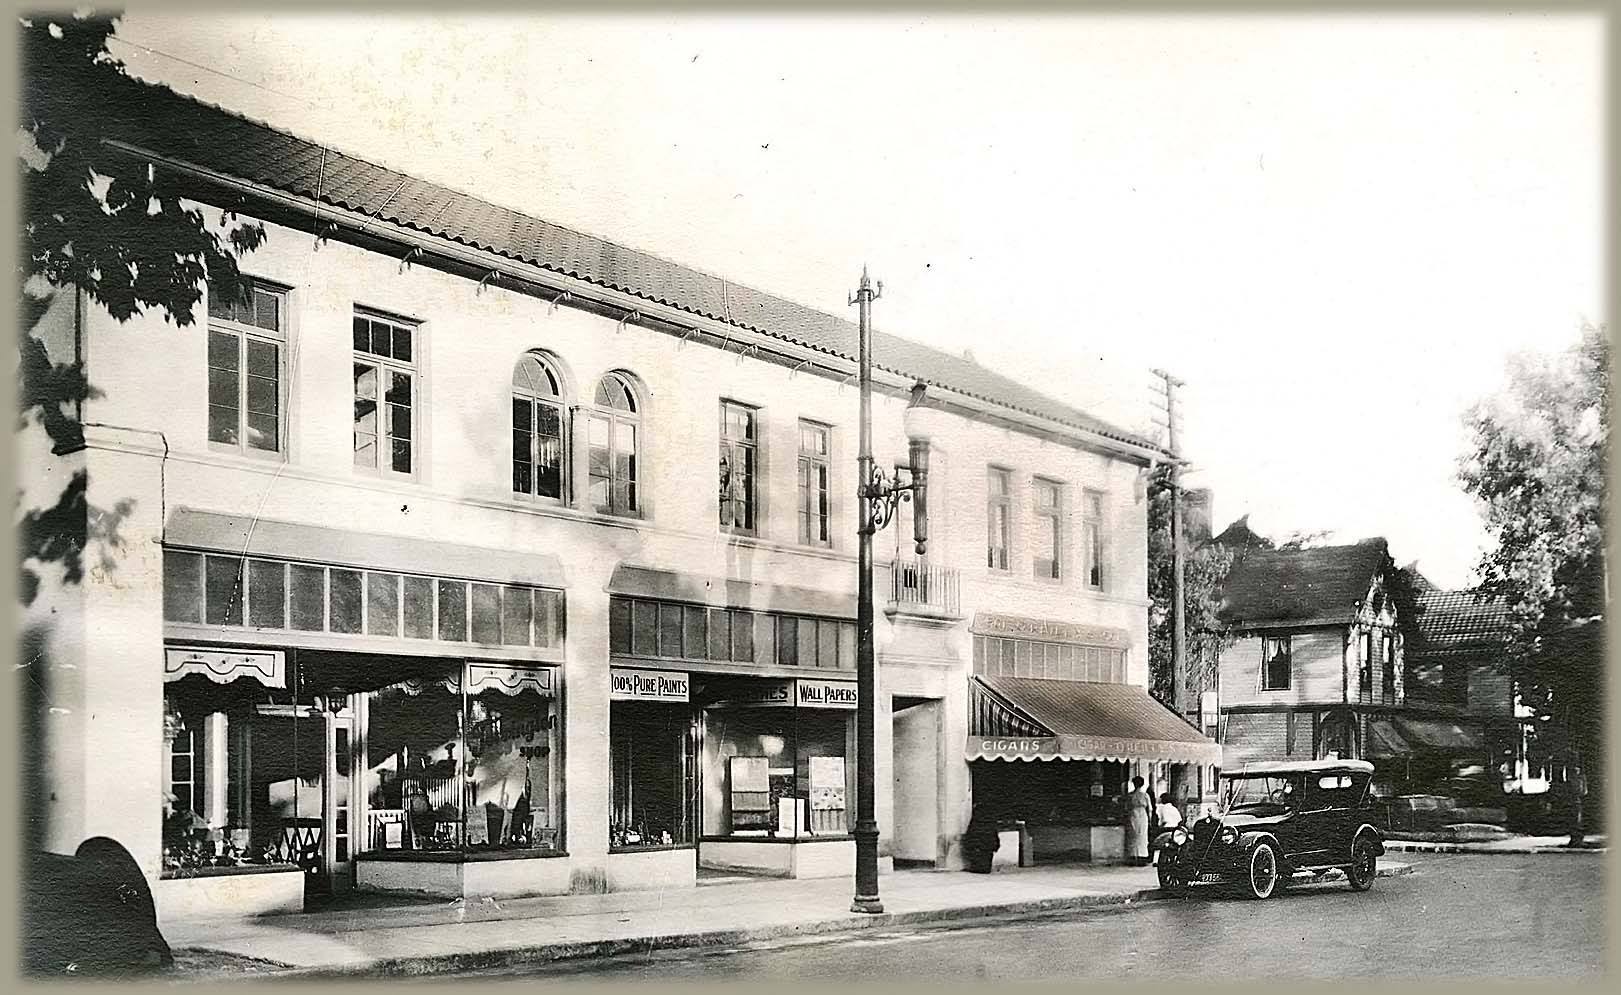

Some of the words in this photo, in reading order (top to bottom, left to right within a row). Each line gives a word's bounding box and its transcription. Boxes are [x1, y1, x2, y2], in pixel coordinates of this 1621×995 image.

[611, 674, 633, 693] 100%
[633, 674, 656, 694] PURE
[658, 676, 687, 696] PAINTS
[800, 685, 823, 703] WALL
[824, 686, 857, 704] PAPERS
[982, 740, 1040, 751] CIGARS
